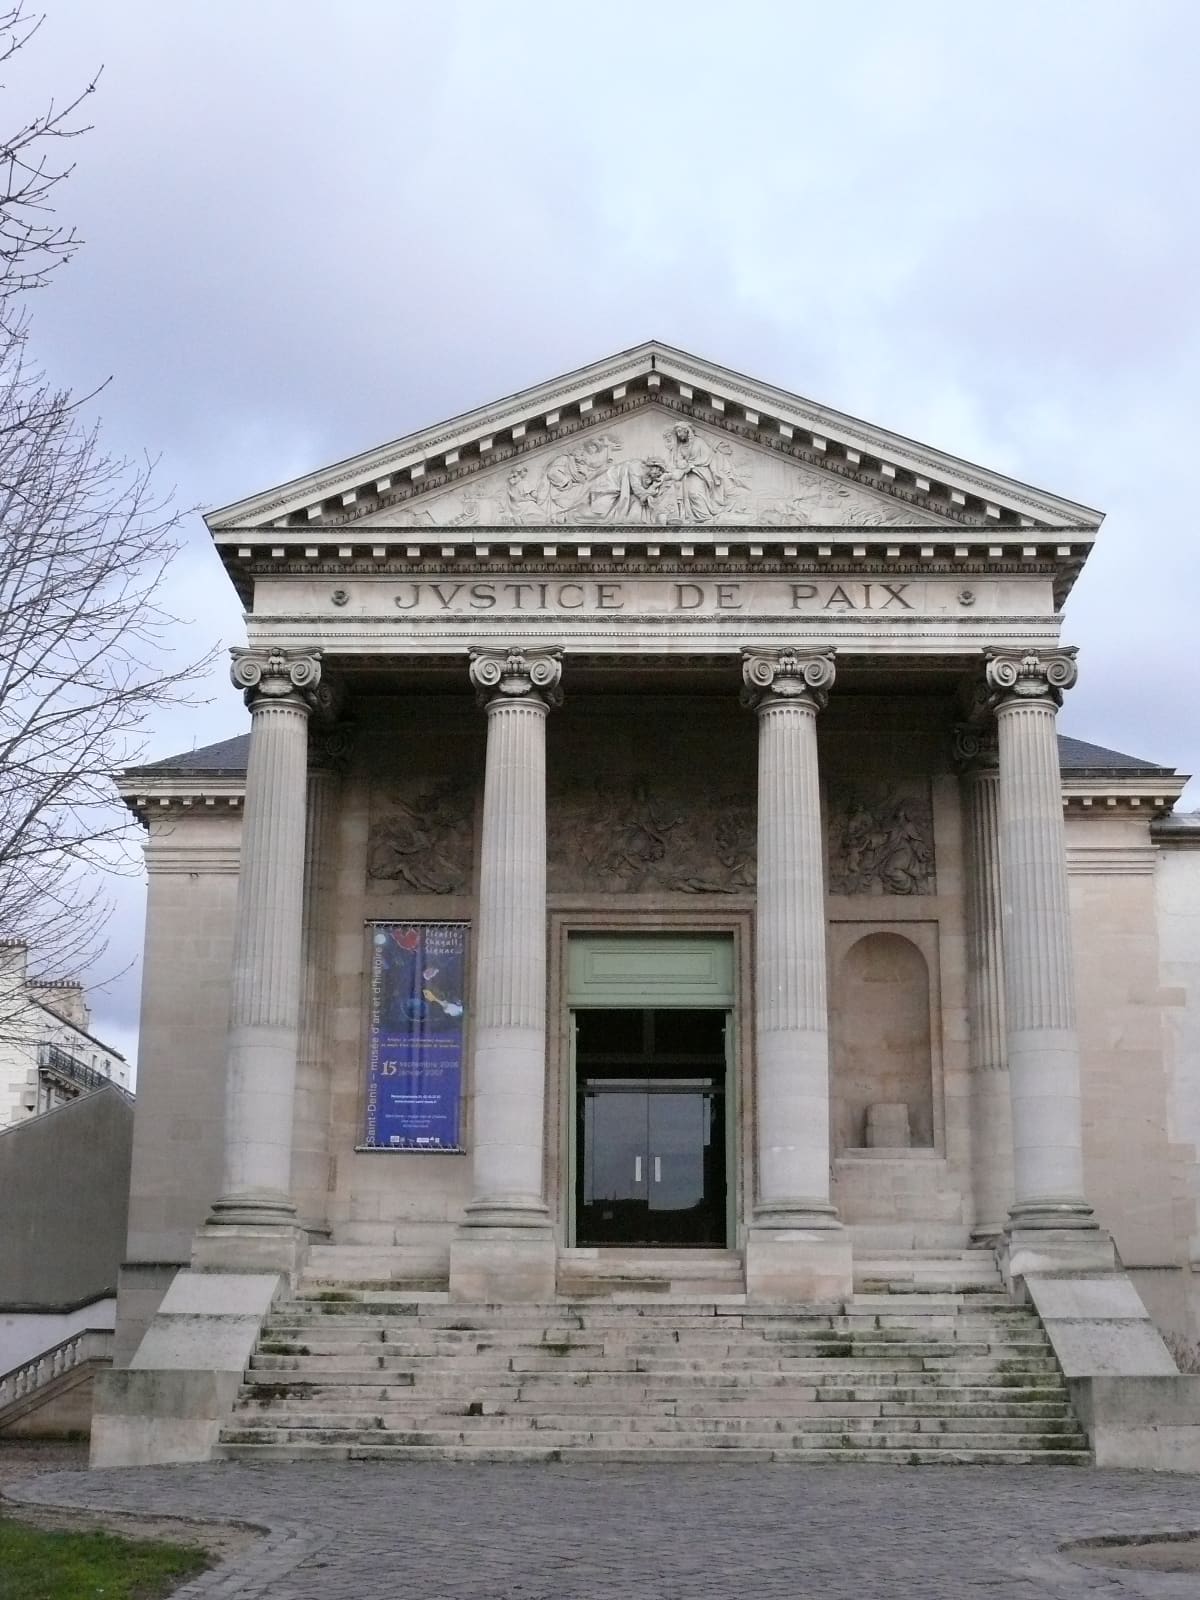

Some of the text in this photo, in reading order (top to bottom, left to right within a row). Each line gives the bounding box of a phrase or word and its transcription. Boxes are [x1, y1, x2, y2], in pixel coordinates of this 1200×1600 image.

[394, 584, 915, 609] JVSTICE DE PAIX
[372, 946, 383, 994] d'histoire
[373, 997, 381, 1007] et
[370, 1037, 379, 1071] musée
[381, 1060, 397, 1076] 15
[367, 1083, 377, 1144] Saint-Denis
